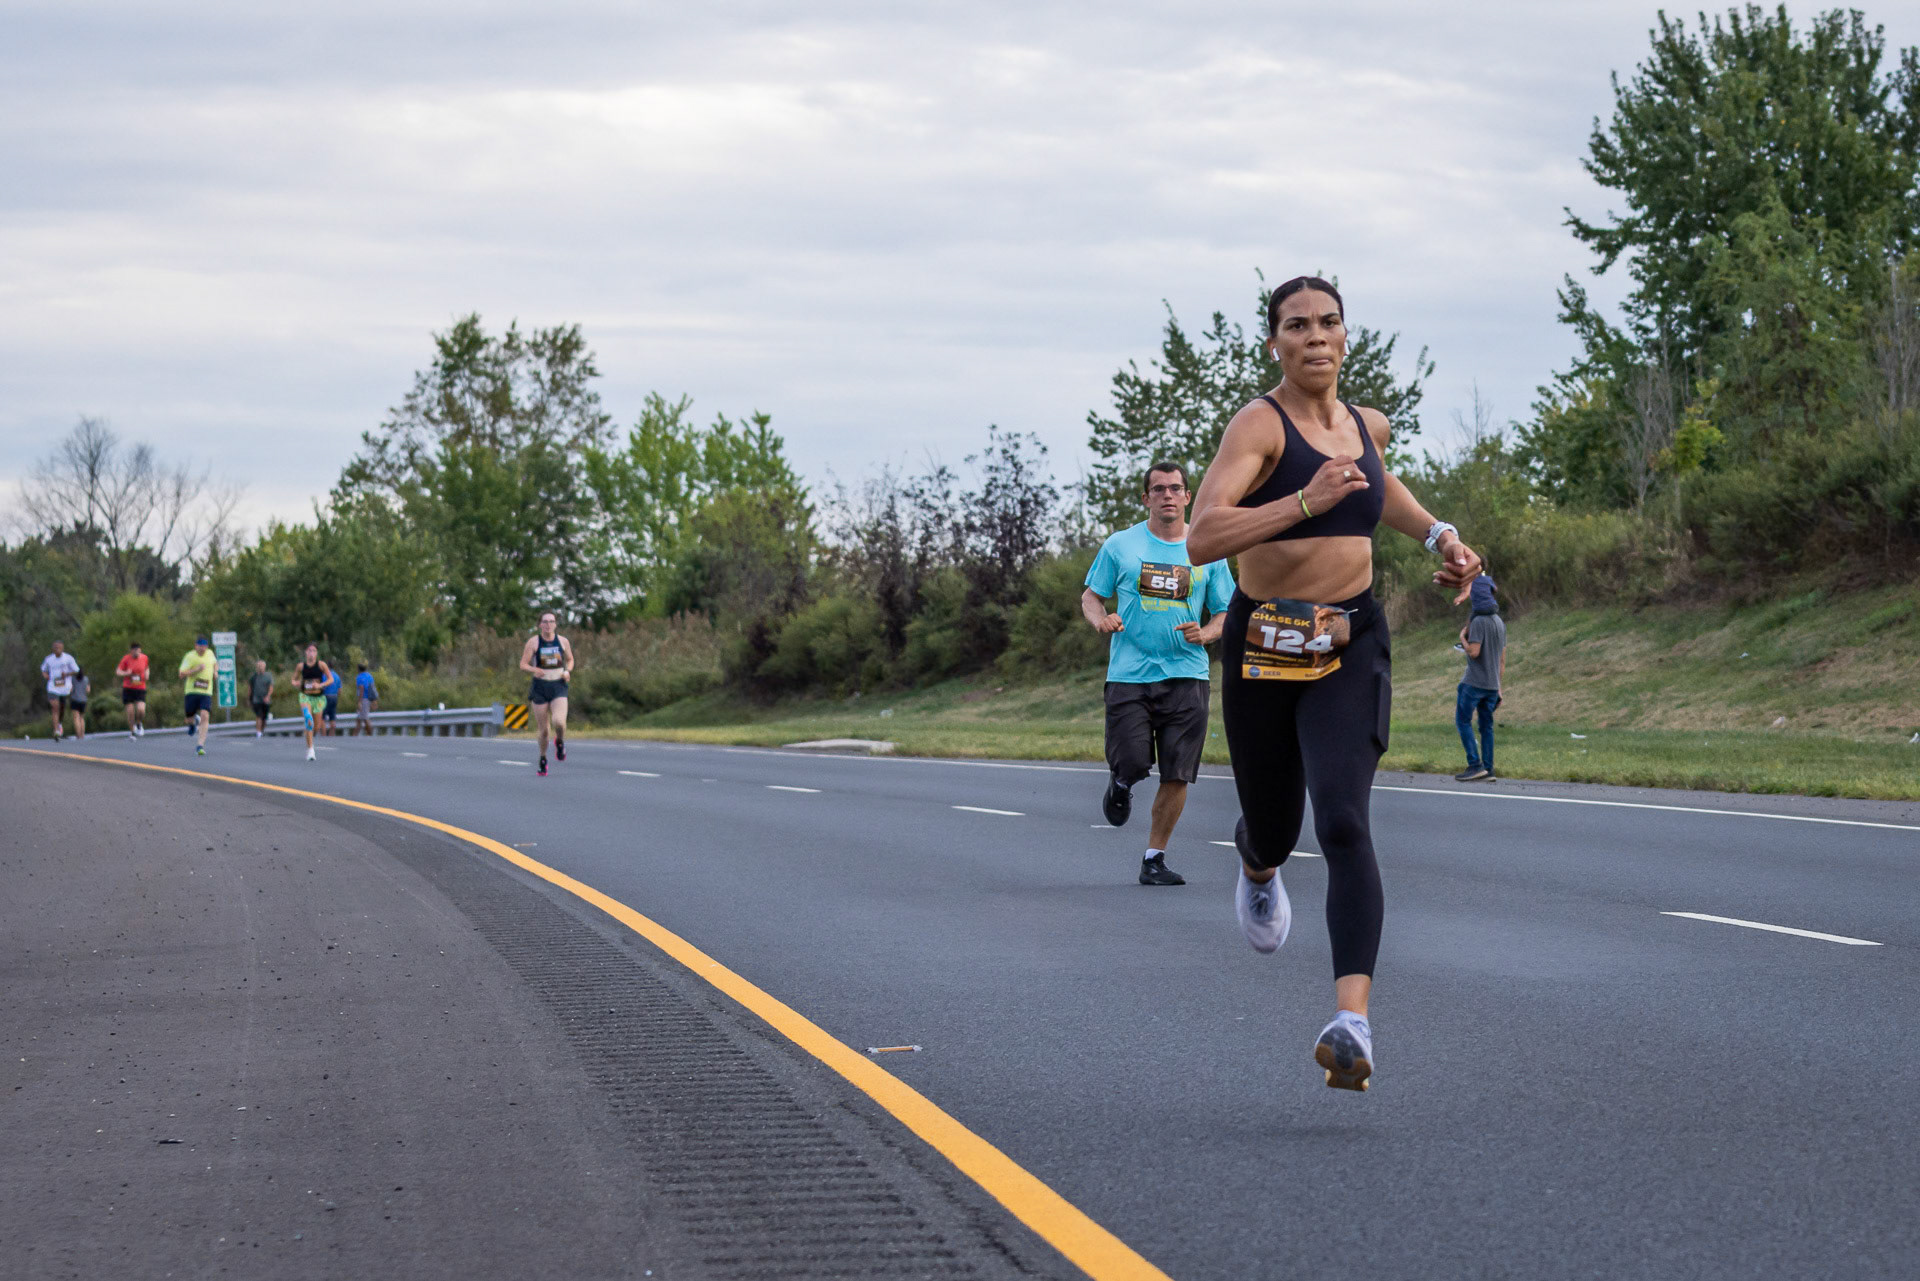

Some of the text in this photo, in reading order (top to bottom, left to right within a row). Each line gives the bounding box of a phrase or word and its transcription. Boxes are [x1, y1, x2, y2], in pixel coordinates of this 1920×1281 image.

[1151, 576, 1178, 590] 55
[1252, 612, 1311, 628] CHASE 5K
[1260, 625, 1332, 654] 124
